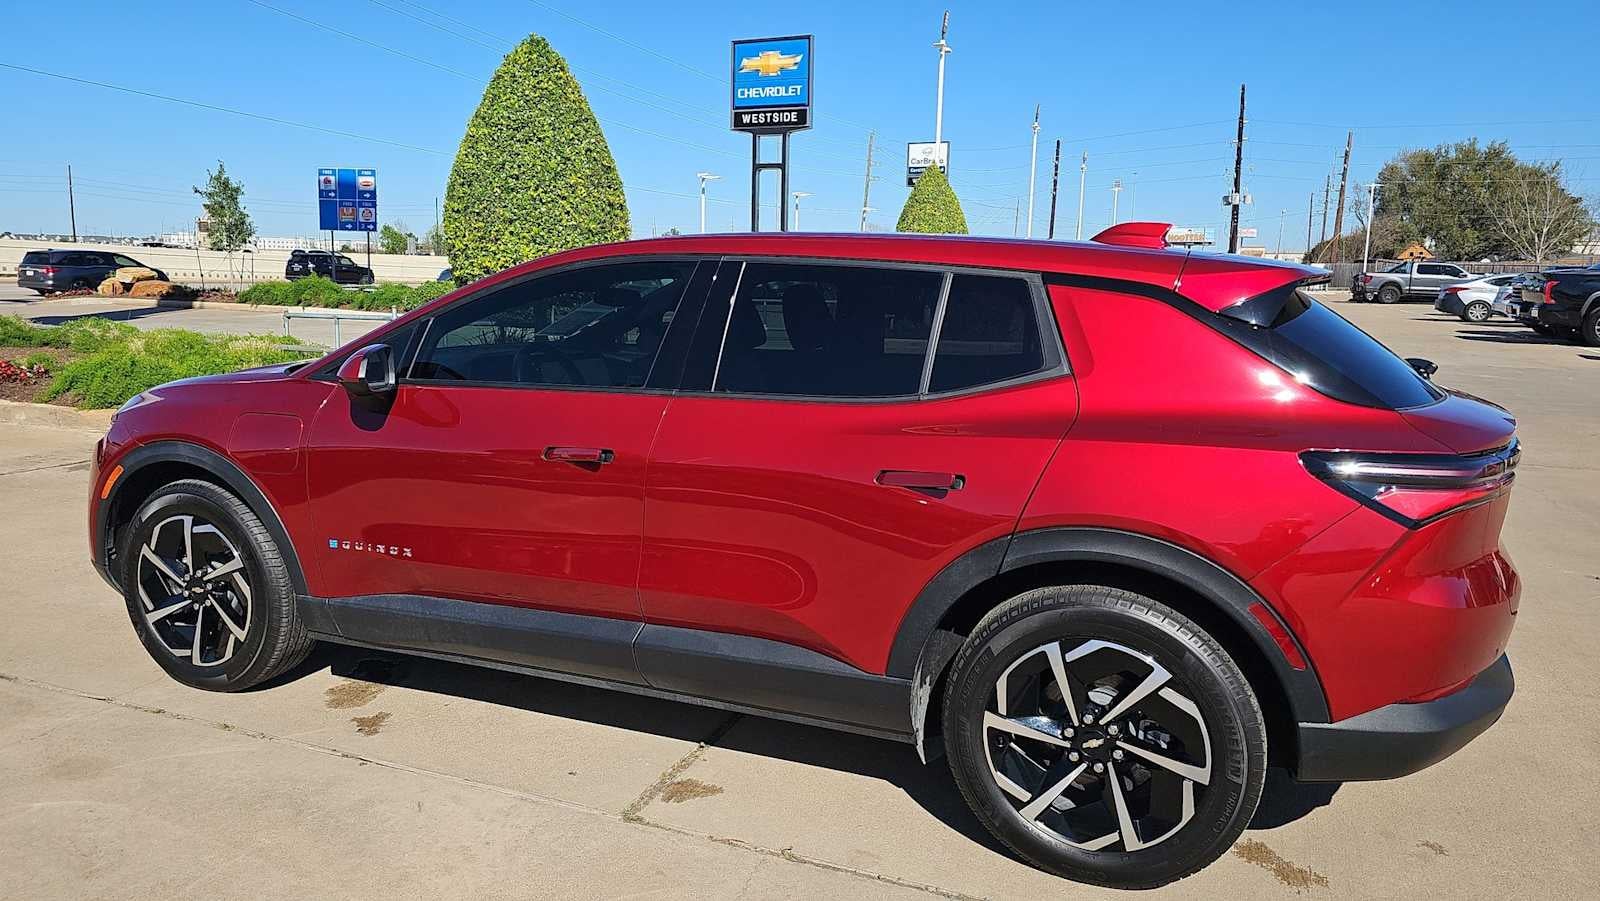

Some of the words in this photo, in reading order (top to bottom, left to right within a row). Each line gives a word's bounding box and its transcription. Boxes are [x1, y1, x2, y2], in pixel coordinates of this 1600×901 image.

[737, 85, 803, 99] CHEVROLET
[741, 111, 798, 124] WESTSIDE
[910, 157, 944, 165] CarBro
[328, 539, 412, 557] EQUINOX
